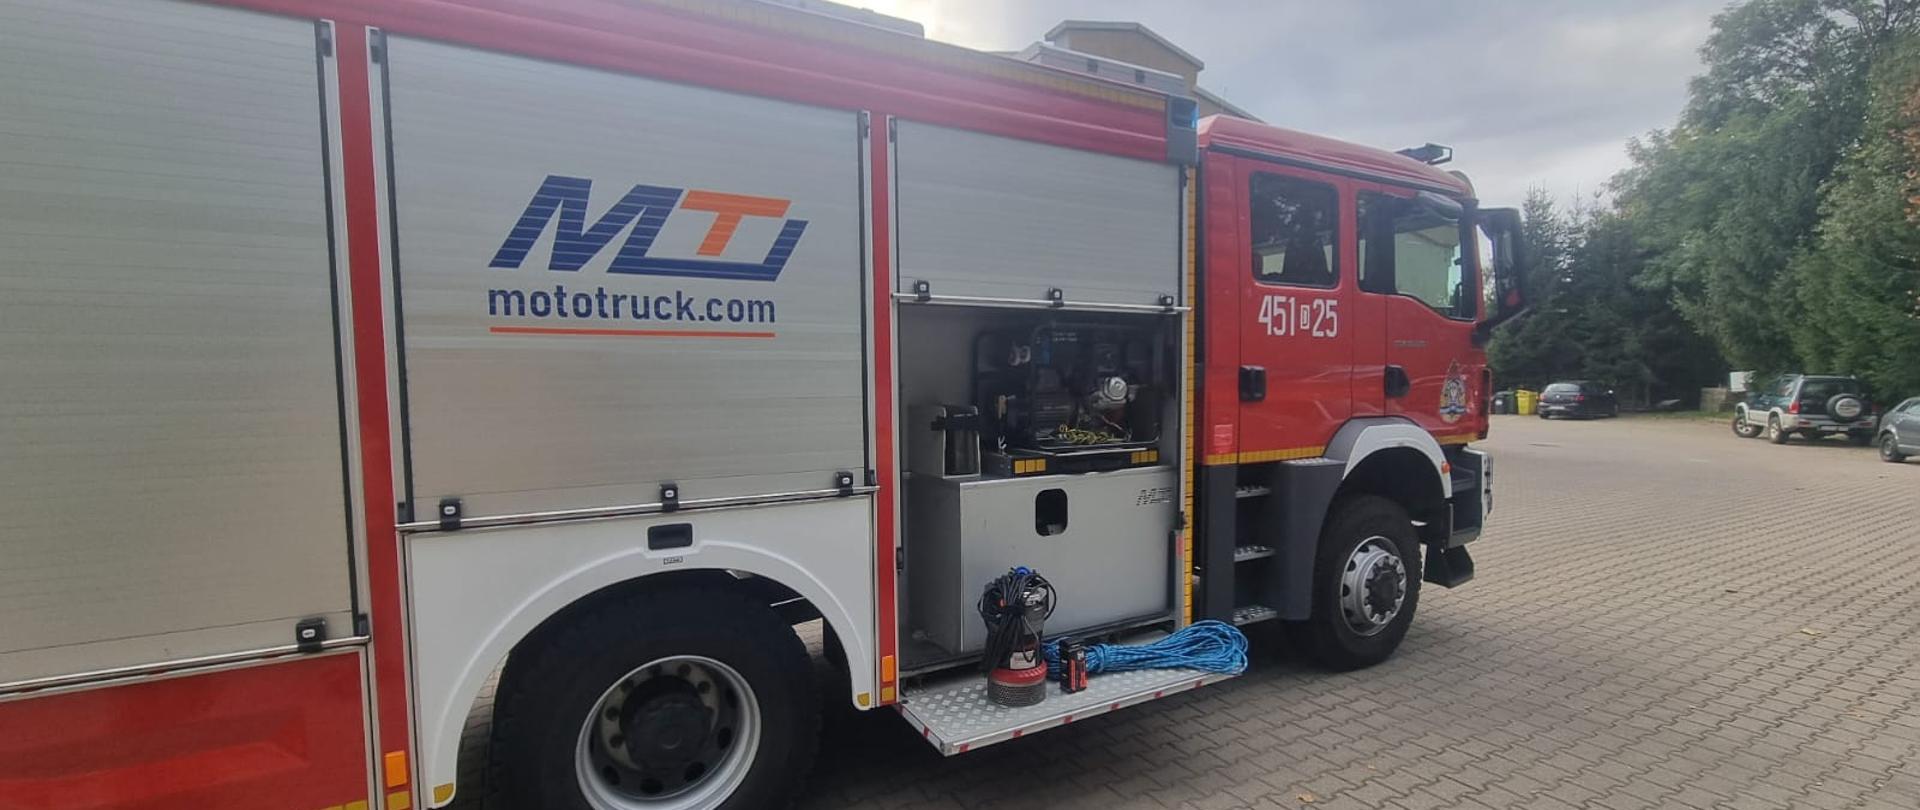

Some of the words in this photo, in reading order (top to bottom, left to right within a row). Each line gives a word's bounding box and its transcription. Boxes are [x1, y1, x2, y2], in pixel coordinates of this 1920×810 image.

[488, 285, 776, 324] mototruck.com
[1258, 294, 1296, 336] 451
[1312, 298, 1338, 338] 25
